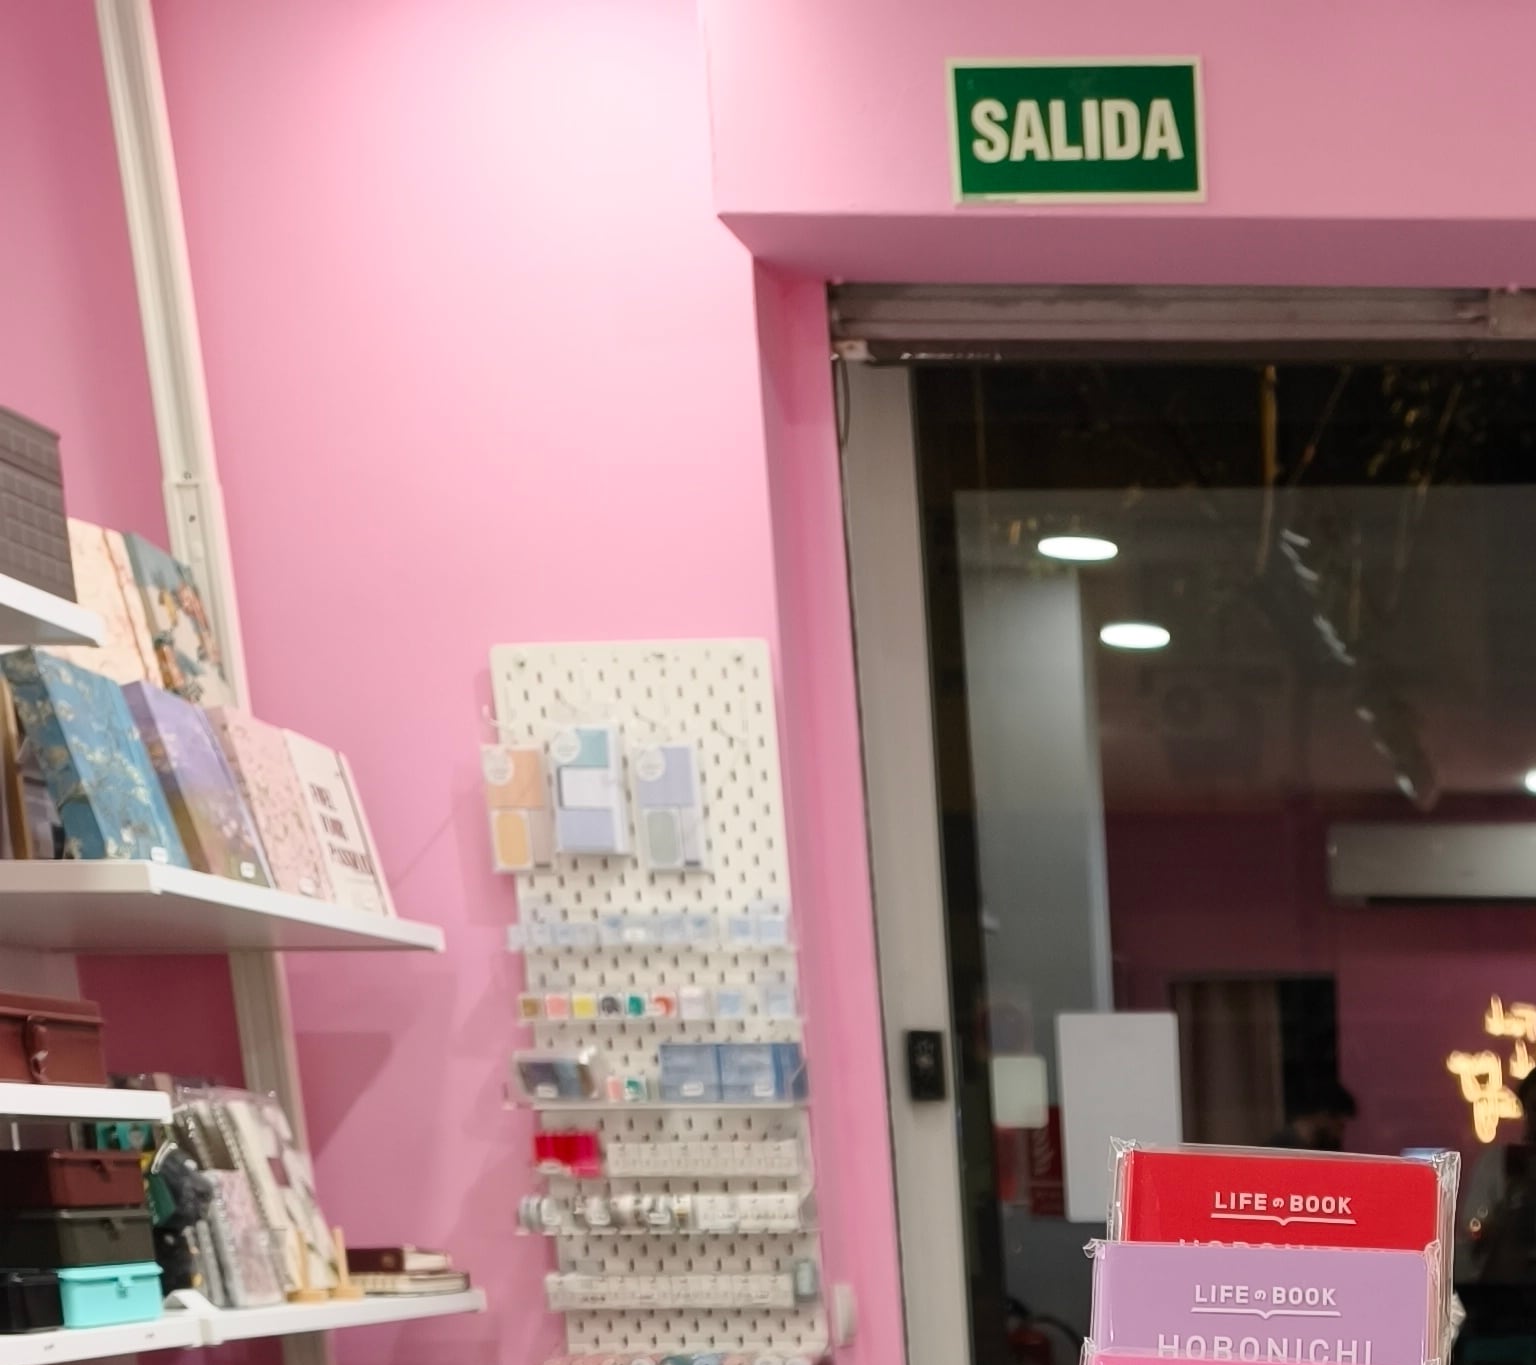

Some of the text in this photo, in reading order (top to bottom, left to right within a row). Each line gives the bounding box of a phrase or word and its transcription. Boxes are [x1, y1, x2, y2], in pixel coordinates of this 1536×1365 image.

[971, 98, 1183, 163] SALIDA
[1215, 1191, 1267, 1210] LIFE
[1289, 1195, 1352, 1214] BOOK
[1195, 1284, 1248, 1304] LIFE
[1272, 1287, 1337, 1306] BOOK
[1157, 1334, 1373, 1365] HOBONICHI
